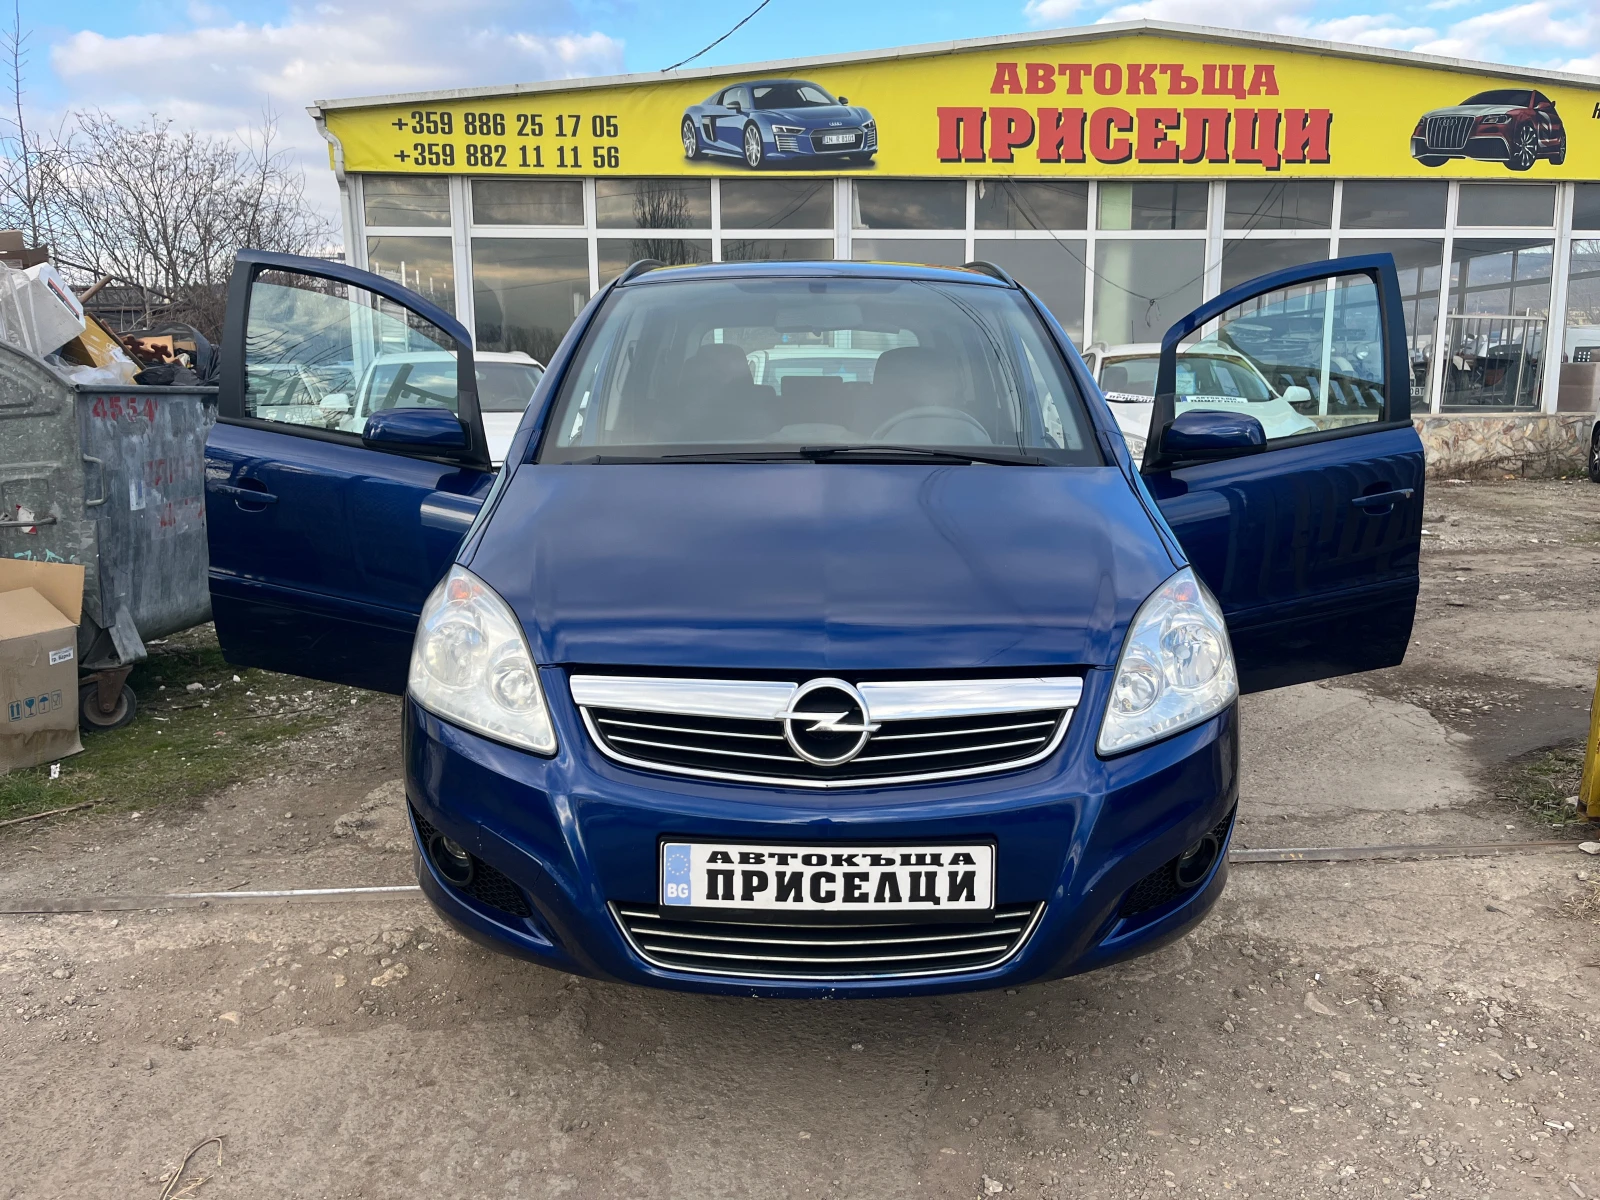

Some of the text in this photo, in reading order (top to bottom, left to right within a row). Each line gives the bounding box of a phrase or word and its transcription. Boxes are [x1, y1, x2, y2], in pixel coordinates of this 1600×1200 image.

[990, 62, 1279, 100] АВТОКЪЩА
[391, 110, 619, 138] +359 886 25 17 05
[936, 106, 1333, 171] ПРИСЕЛЦИ
[393, 142, 620, 169] +359 882 11 11 56
[705, 850, 977, 868] АВТОКЪЩА
[667, 883, 689, 898] BG
[705, 868, 977, 906] ПРИСЕЛЦИ
